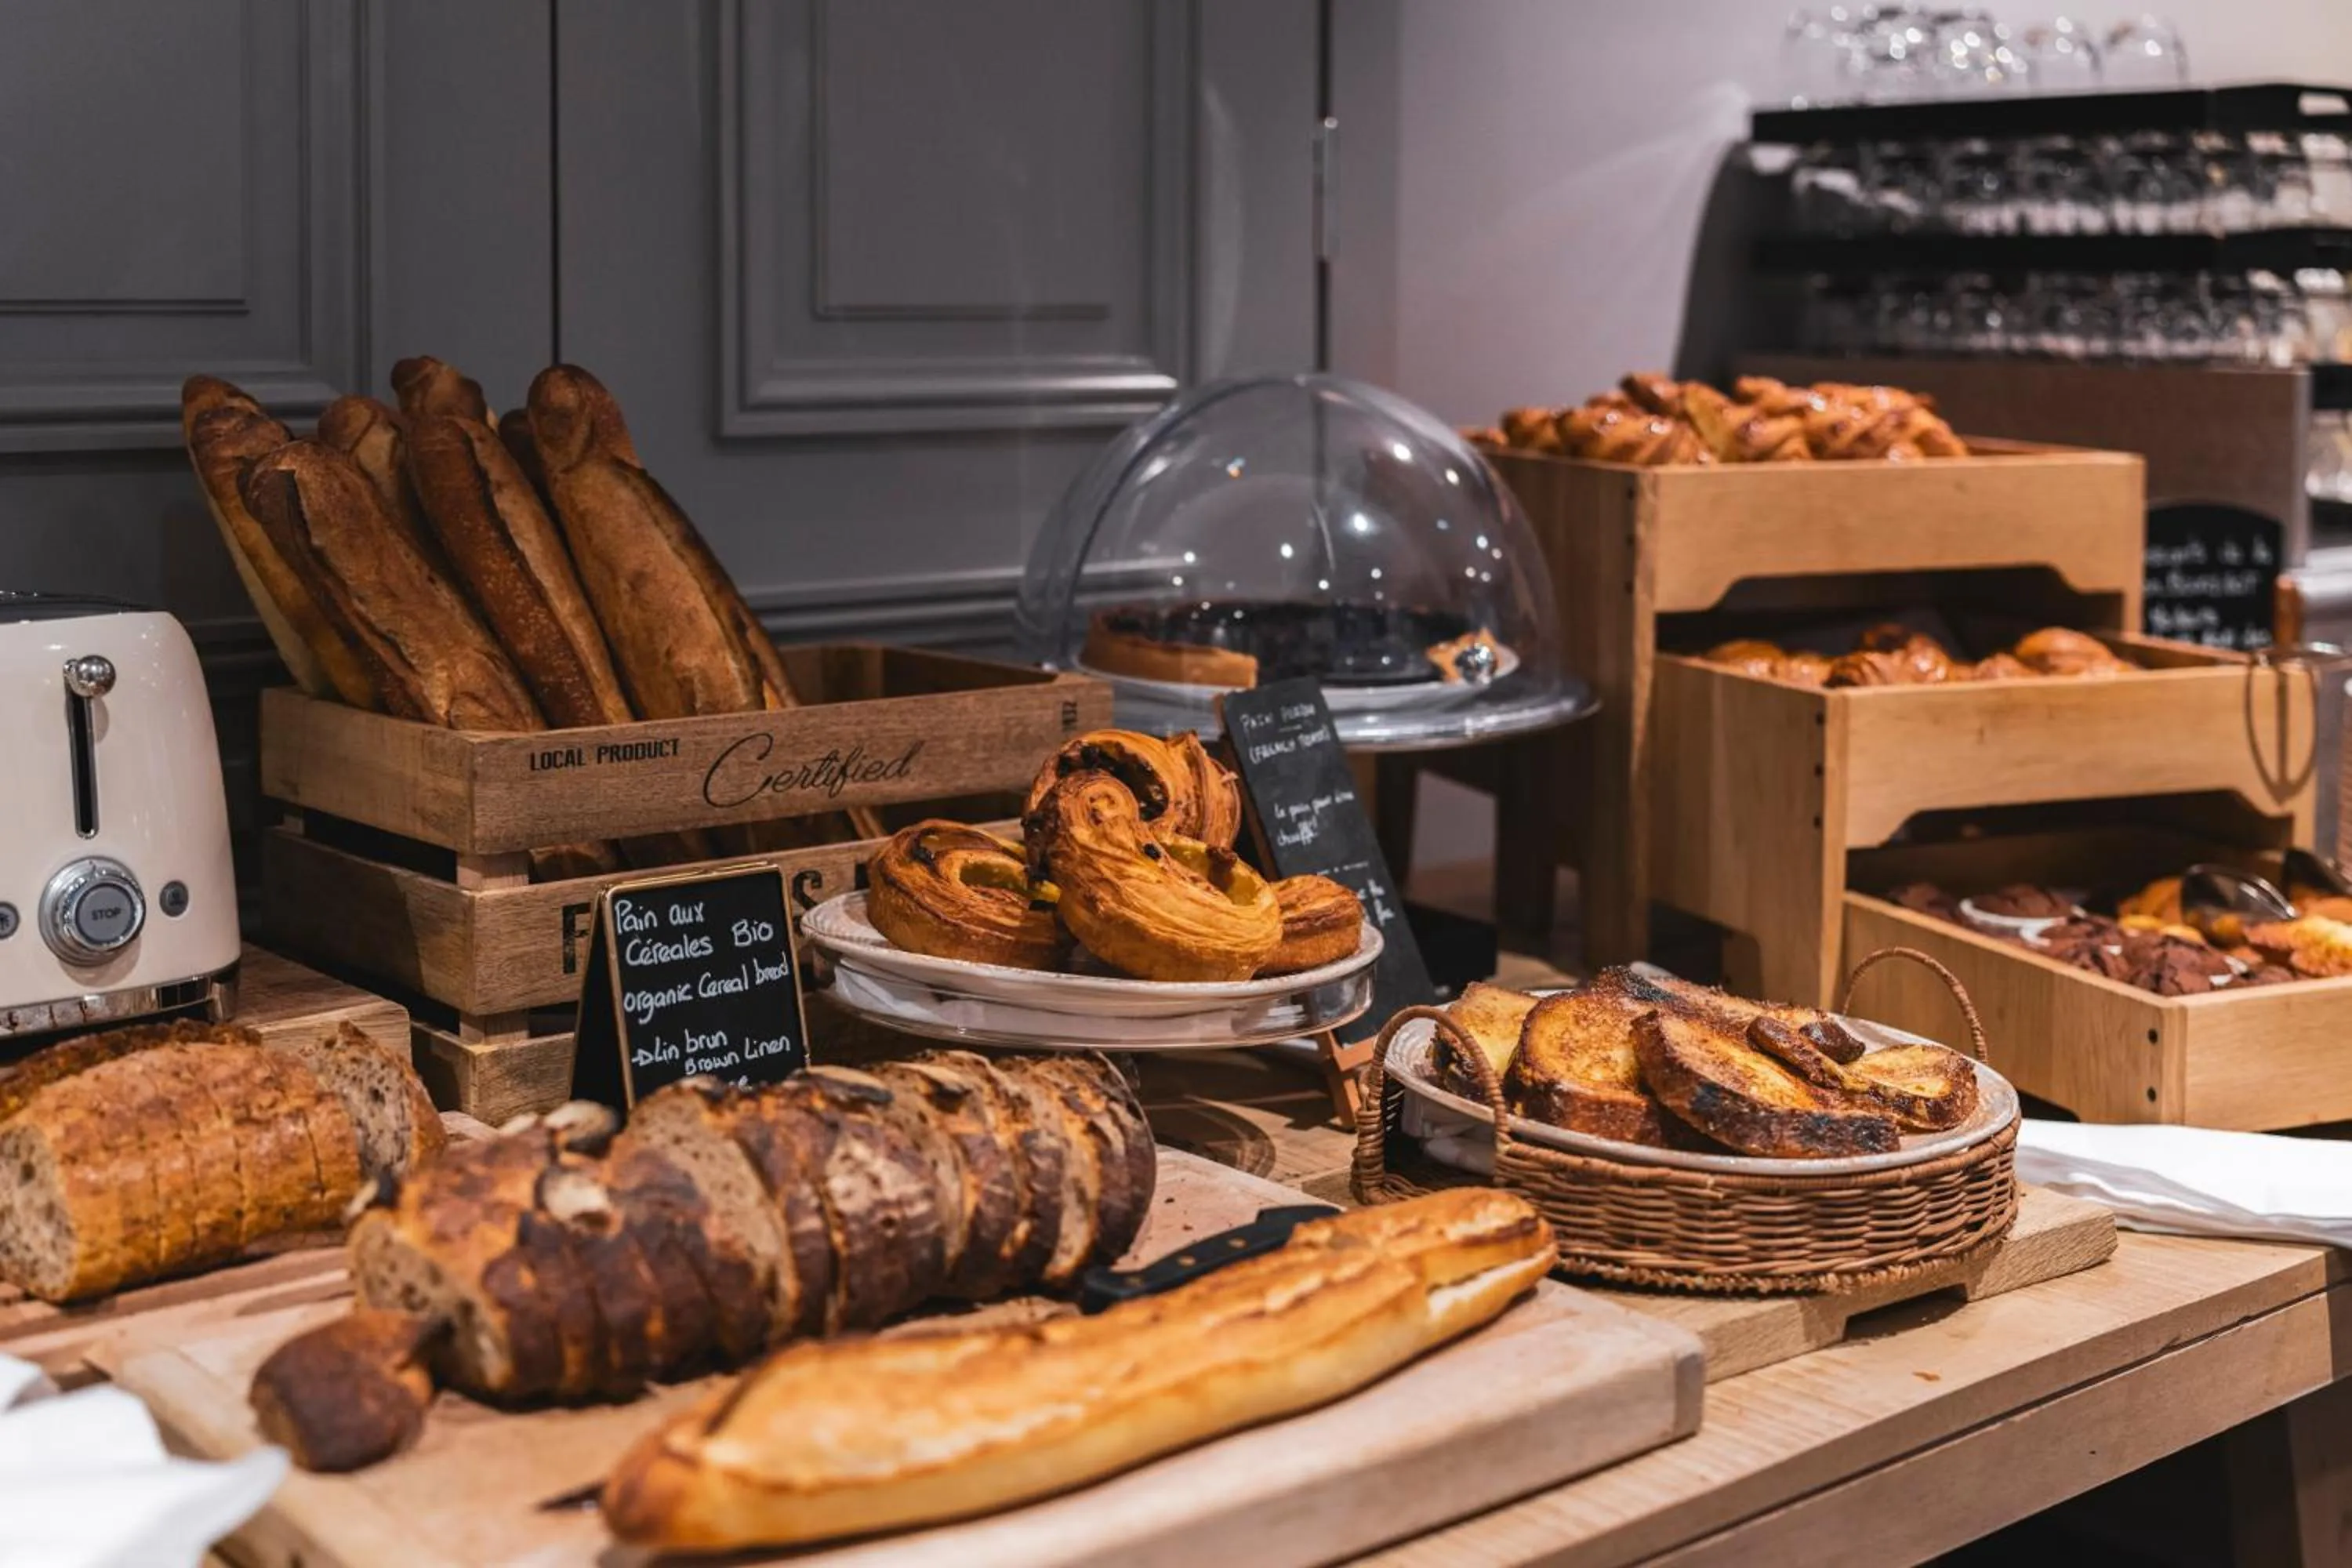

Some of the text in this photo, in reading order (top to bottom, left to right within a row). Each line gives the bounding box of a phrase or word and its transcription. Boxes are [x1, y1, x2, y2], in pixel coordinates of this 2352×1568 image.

[529, 738, 680, 771] LOCAL PRODUCT
[702, 732, 926, 808] Certified
[92, 907, 122, 921] STOP
[614, 899, 705, 935] Pain aux
[731, 918, 774, 948] Bio
[698, 963, 749, 999] Cereal
[753, 950, 789, 985] bread
[684, 1028, 728, 1054] brun
[684, 1035, 790, 1076] Brown Linen
